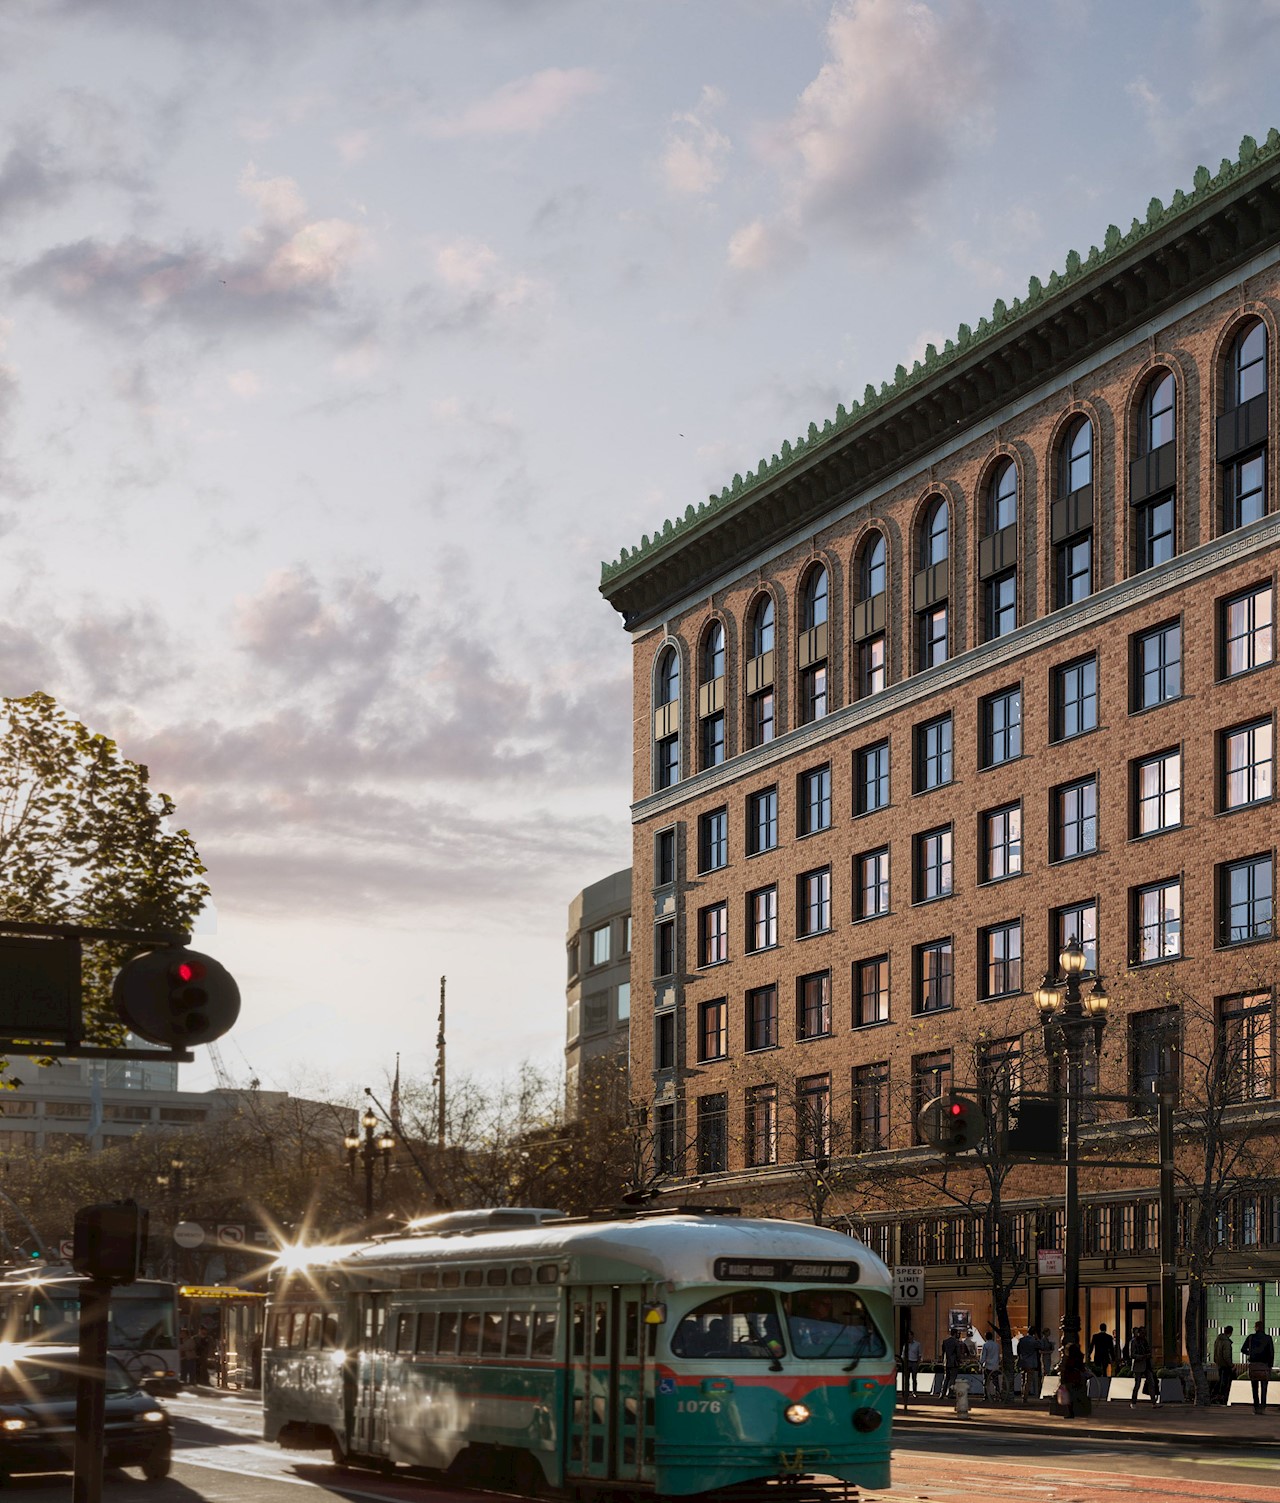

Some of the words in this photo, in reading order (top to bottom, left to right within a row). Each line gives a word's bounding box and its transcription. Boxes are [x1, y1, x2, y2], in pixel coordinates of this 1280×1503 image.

[720, 1262, 727, 1277] F
[899, 1285, 918, 1298] 10
[676, 1400, 721, 1414] 1076
